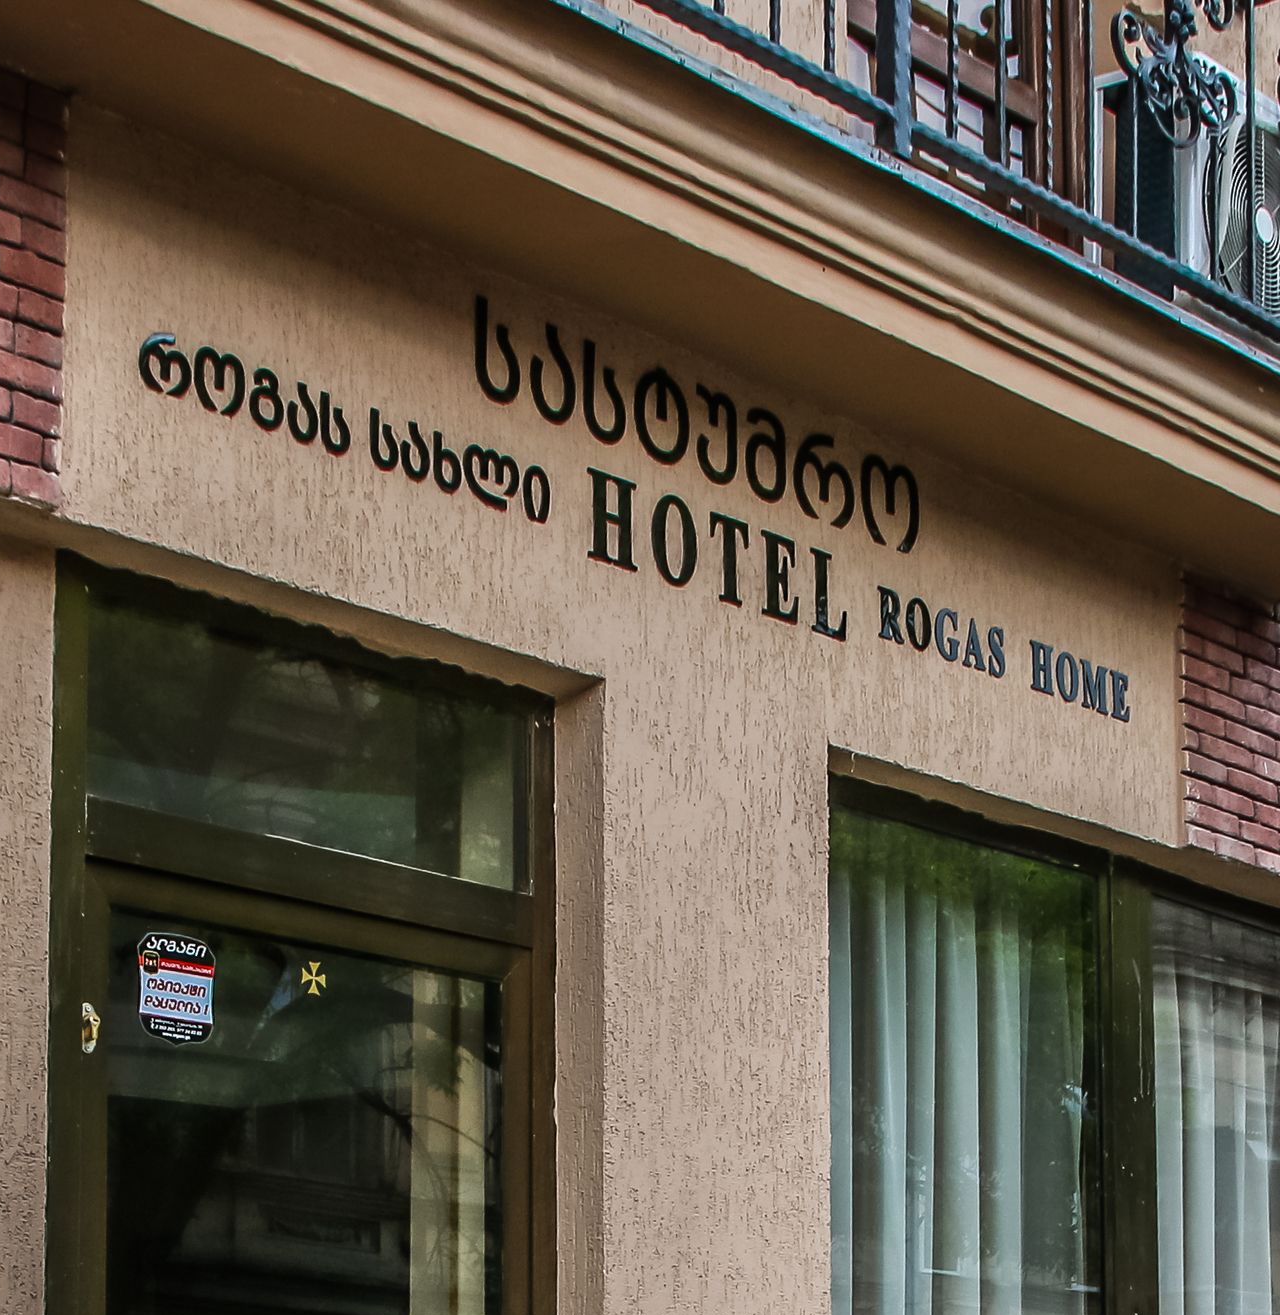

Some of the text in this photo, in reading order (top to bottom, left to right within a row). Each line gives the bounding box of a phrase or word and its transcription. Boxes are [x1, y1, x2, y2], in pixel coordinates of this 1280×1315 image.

[139, 333, 551, 523] როგას სახლი
[475, 296, 920, 553] სასტუმრო
[587, 466, 1131, 723] HOTEL ROGAS HOME
[147, 978, 206, 998] ობიექტი
